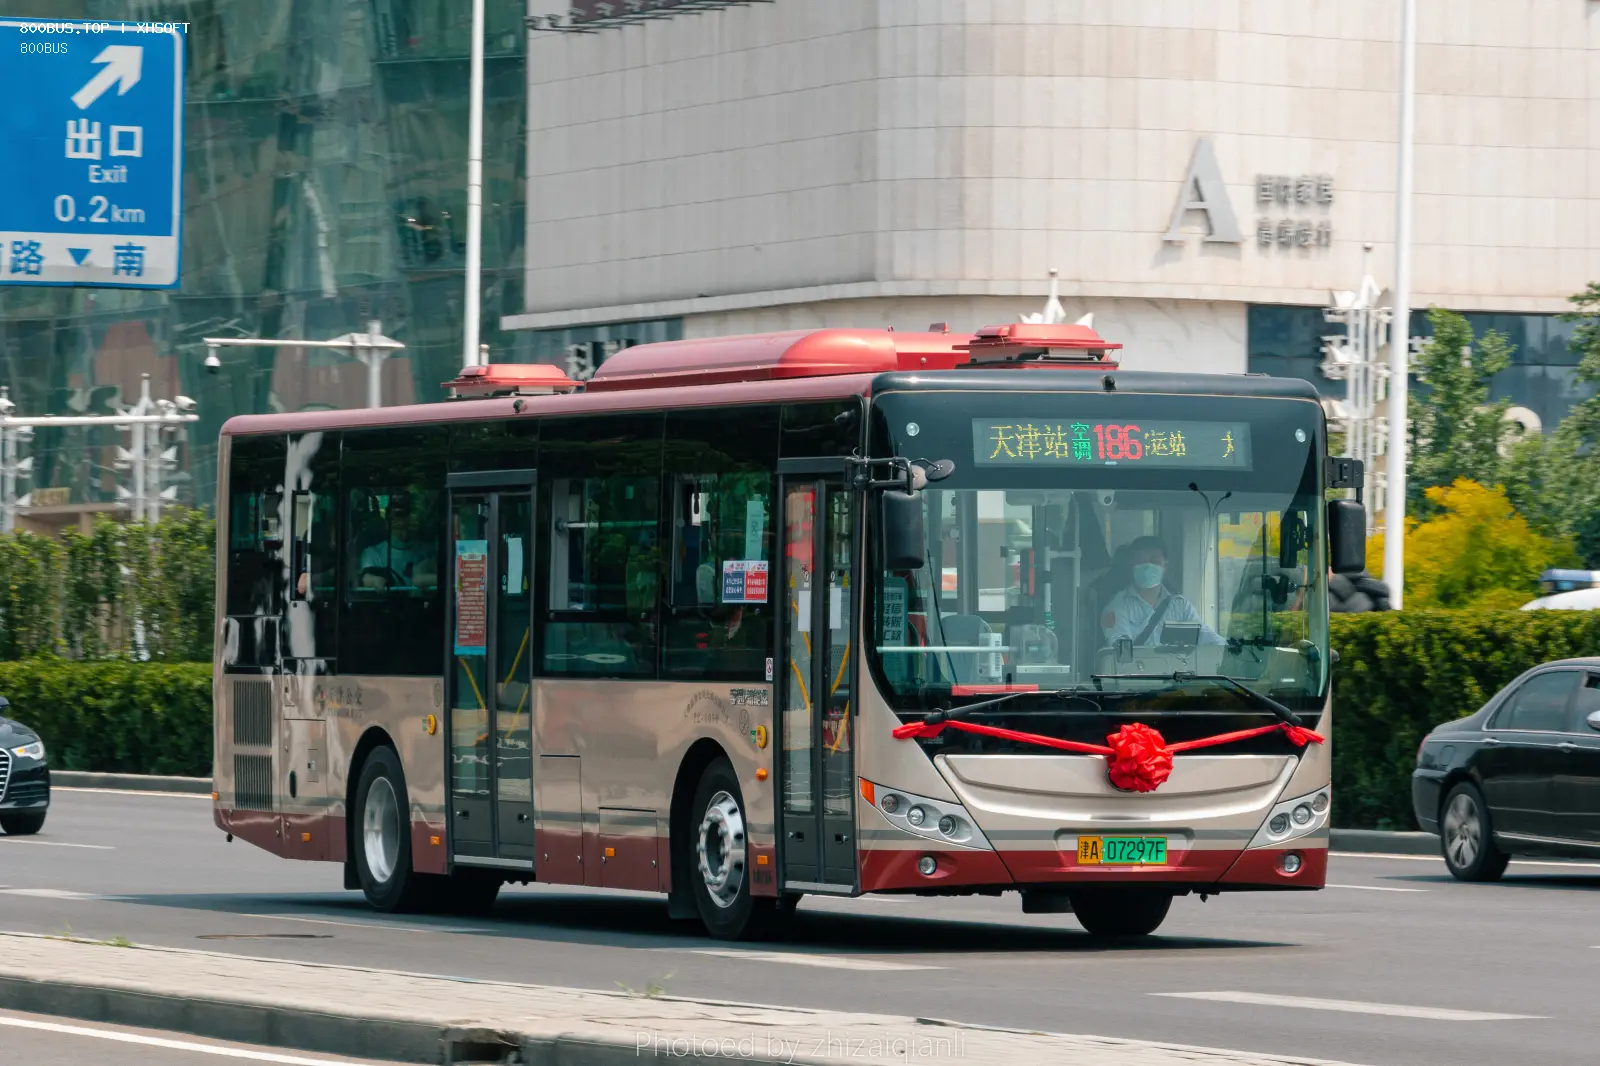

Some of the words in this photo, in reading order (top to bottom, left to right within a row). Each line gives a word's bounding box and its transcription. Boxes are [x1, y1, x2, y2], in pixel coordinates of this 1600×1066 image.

[64, 118, 144, 161] 出口
[88, 164, 128, 184] Exit
[1160, 138, 1244, 244] A
[54, 194, 146, 224] 0.2km
[0, 239, 46, 276] 路
[112, 241, 147, 277] 南
[989, 423, 1069, 460] 天津站
[1070, 422, 1092, 461] 空调
[1093, 423, 1143, 460] 186
